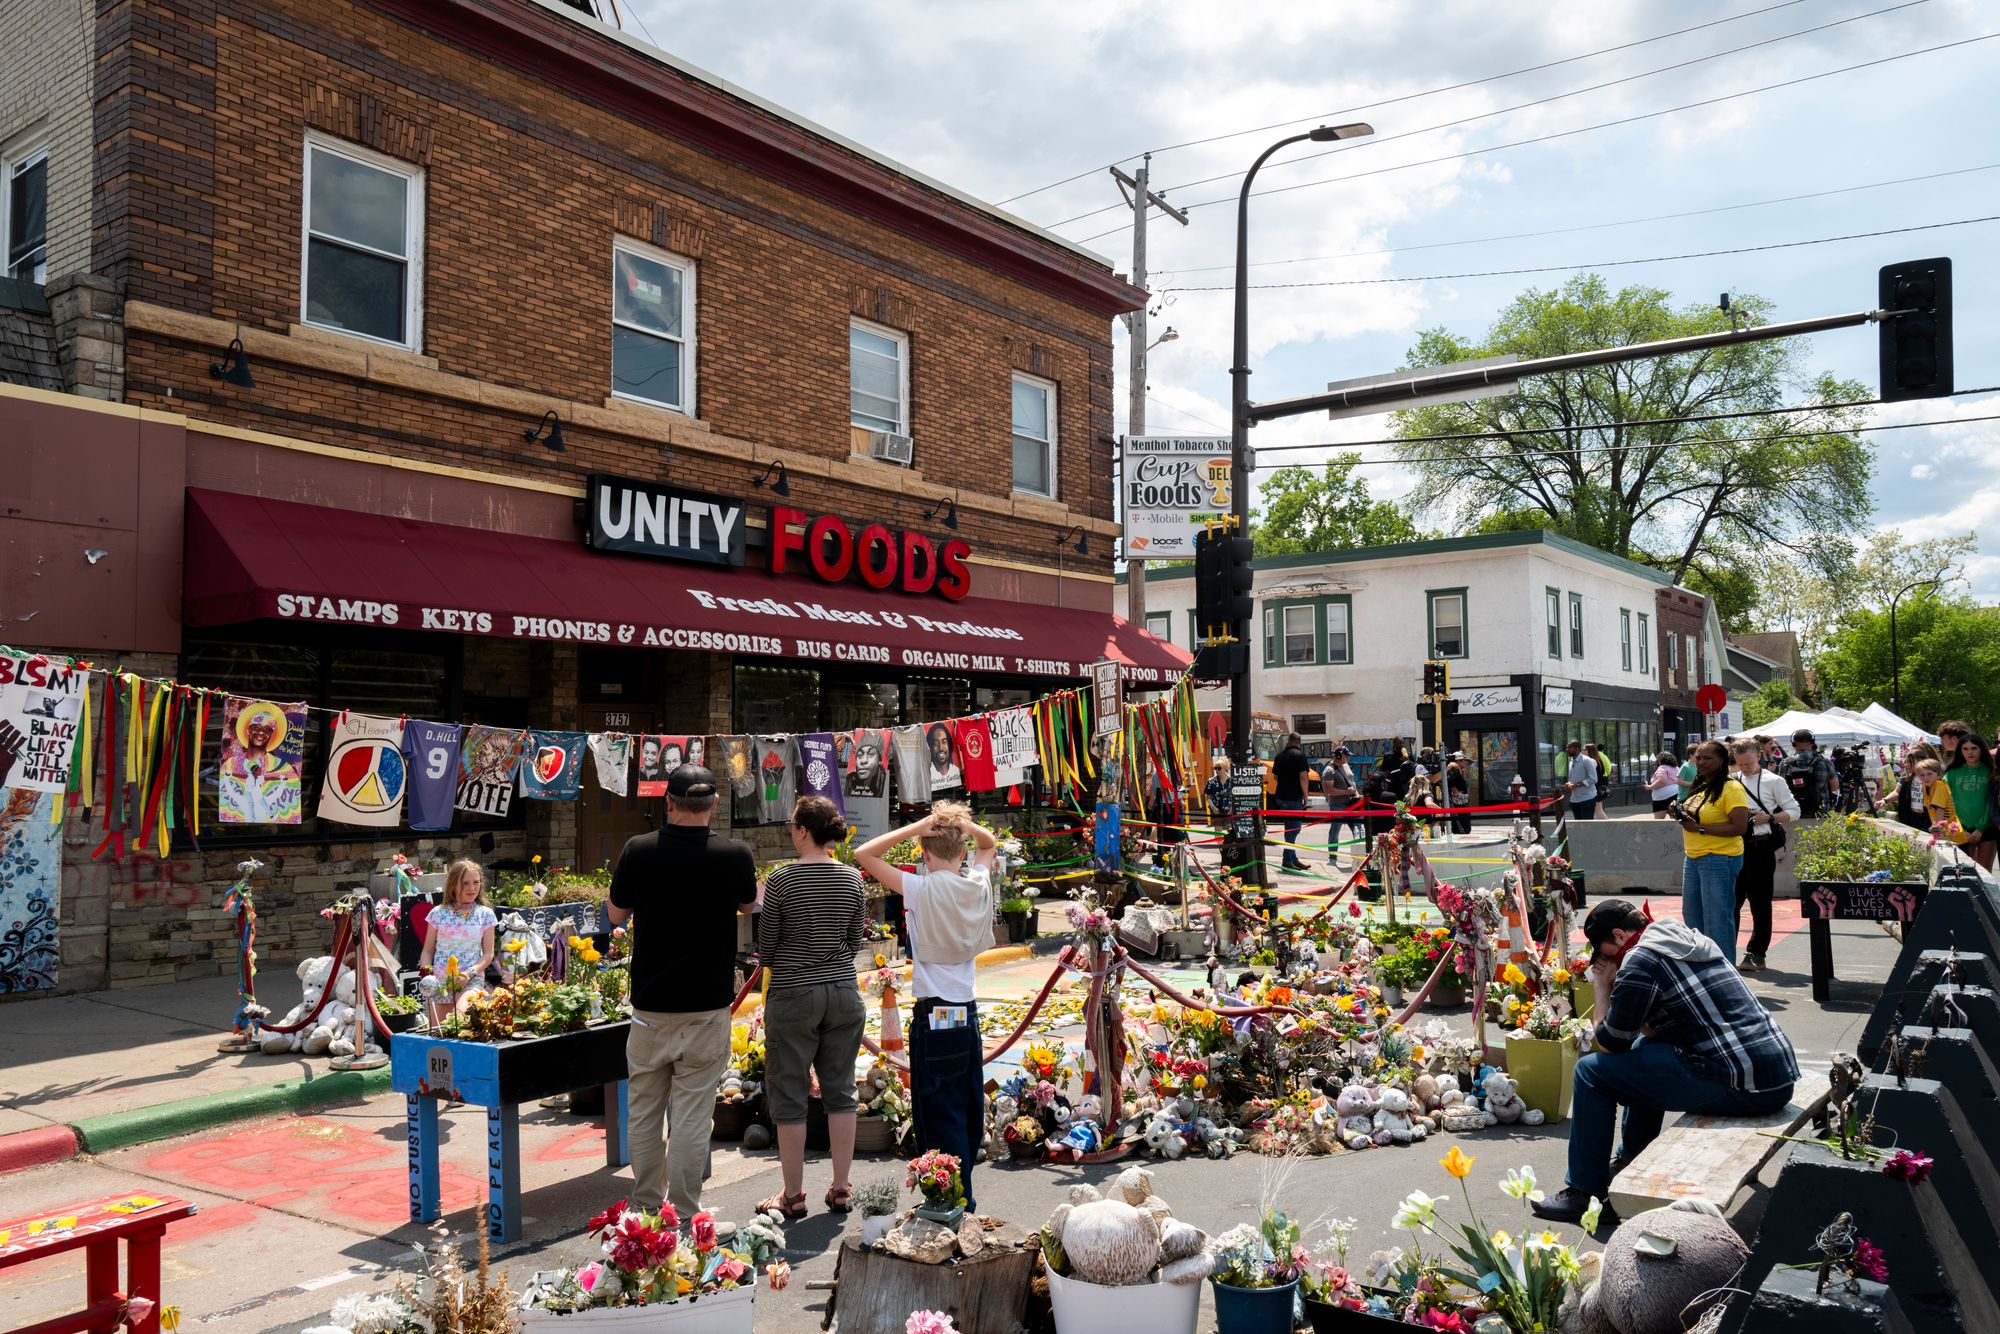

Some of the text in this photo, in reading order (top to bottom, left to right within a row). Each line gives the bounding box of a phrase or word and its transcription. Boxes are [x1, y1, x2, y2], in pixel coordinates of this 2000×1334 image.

[1131, 440, 1170, 451] Menthol
[1174, 440, 1214, 451] Tobacco
[1137, 456, 1196, 487] Cup
[1130, 482, 1202, 505] Foods
[600, 485, 740, 554] UNITY
[1152, 537, 1183, 545] boost
[768, 505, 972, 600] FOODS
[687, 589, 1025, 641] Fresh Meat & Produce
[277, 593, 399, 625] STAMPS
[421, 607, 493, 633] KEYS
[513, 616, 610, 642] PHONES
[617, 624, 635, 643] &
[642, 627, 782, 655] ACCESSORIES
[796, 639, 831, 658] BUS
[835, 642, 890, 663] CARDS
[902, 648, 969, 669] ORGANIC
[972, 655, 1006, 671] MILK
[1015, 658, 1070, 676] T-SHIRTS
[1131, 668, 1158, 681] FOOD
[1096, 664, 1118, 683] HISTORIC
[1099, 680, 1117, 699] GEORGE
[1101, 697, 1116, 716] FLOYD
[1471, 693, 1486, 708] &
[1487, 691, 1521, 706] Served
[606, 713, 629, 726] 3757
[987, 715, 1026, 740] BLACK
[1098, 713, 1121, 733] MEMORIAL
[30, 719, 77, 740] BLACK
[26, 736, 66, 758] LIVES
[804, 740, 832, 751] GEORGE FLOYD
[810, 749, 827, 760] SQUARE
[426, 747, 448, 779] 9
[23, 766, 67, 783] MATTER
[1848, 887, 1884, 897] BLACK
[1843, 908, 1892, 917] MATTER
[1850, 898, 1884, 908] LIVES
[431, 1057, 448, 1073] RIP
[408, 1094, 421, 1219] NO JUSTICE
[489, 1109, 503, 1238] NO PEACE
